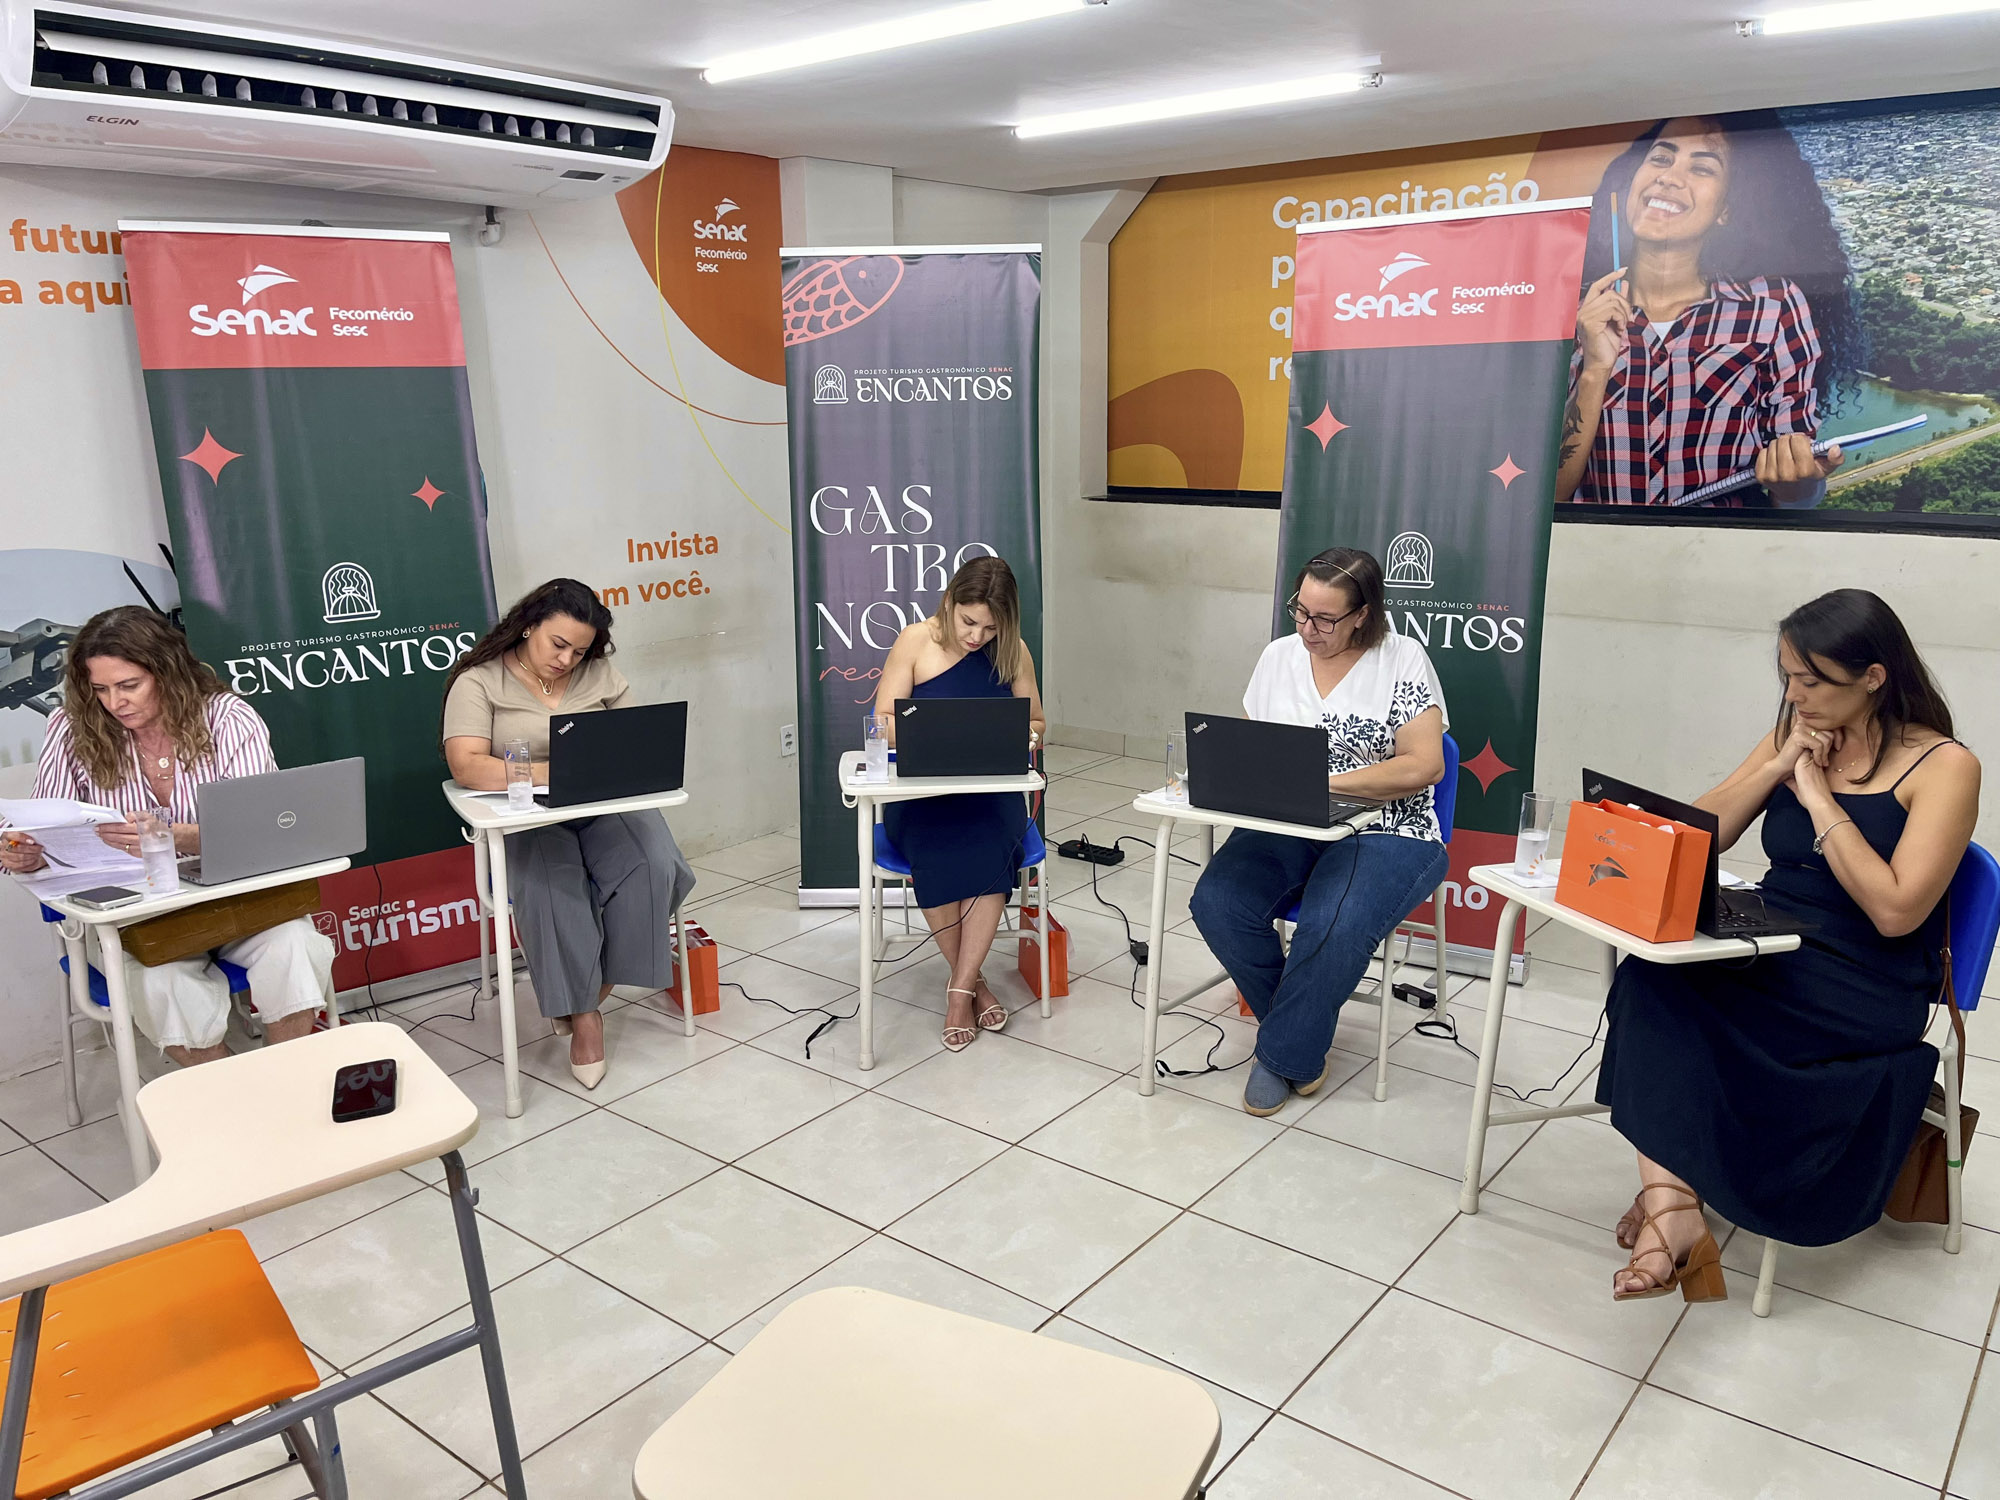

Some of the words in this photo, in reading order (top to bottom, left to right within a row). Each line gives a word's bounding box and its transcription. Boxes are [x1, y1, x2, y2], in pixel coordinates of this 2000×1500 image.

[86, 115, 140, 126] ELGIN
[693, 219, 748, 243] Senac
[695, 246, 748, 261] Fecomércio
[696, 261, 719, 273] Sesc
[1452, 281, 1535, 299] Fecomércio
[329, 306, 414, 321] Fecomércio
[1333, 288, 1439, 321] Senac
[1451, 302, 1486, 315] Sesc
[189, 304, 318, 337] Senac
[332, 323, 369, 337] Sesc
[926, 366, 986, 374] GASTRONÔMICO
[854, 375, 1013, 403] ENCANTOS
[810, 484, 933, 536] GAS
[627, 531, 719, 563] Invista
[638, 570, 711, 603] você.
[1396, 599, 1473, 610] GASTRONÔMICO
[1476, 603, 1510, 612] SENAC
[241, 641, 291, 653] PROJETO
[295, 635, 342, 647] TURISMO
[345, 625, 426, 642] GASTRONÔMICO
[428, 621, 460, 632] SENAC
[224, 631, 476, 696] ENCANTOS
[349, 900, 401, 922] Senac
